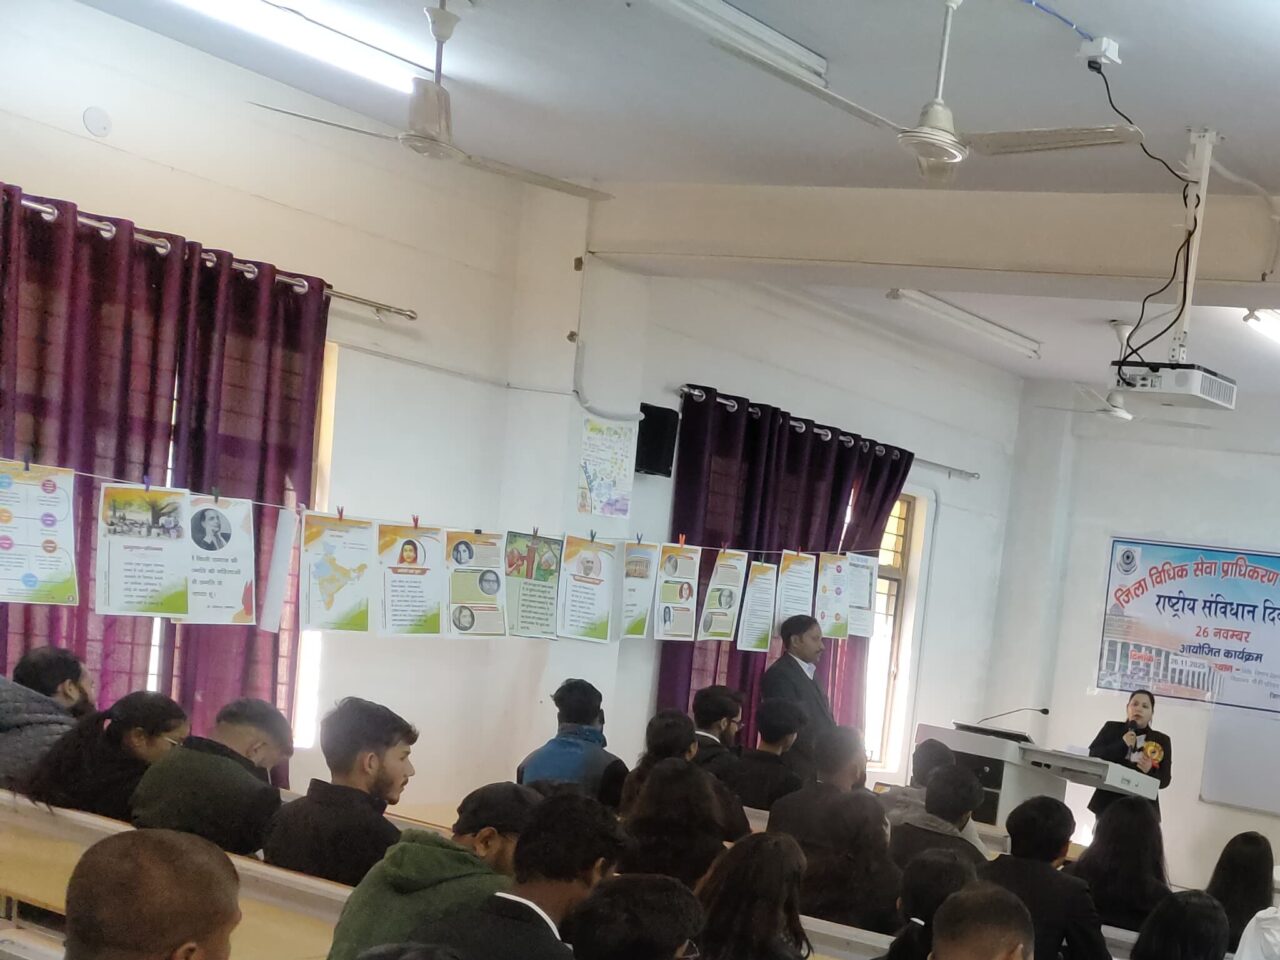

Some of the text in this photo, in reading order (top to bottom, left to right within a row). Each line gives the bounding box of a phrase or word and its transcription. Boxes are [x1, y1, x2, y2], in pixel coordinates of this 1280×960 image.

[1114, 577, 1148, 608] जिला
[1149, 561, 1188, 588] विधिक
[1193, 557, 1218, 577] सेवा
[1221, 556, 1280, 586] प्राधिकरण
[1155, 590, 1199, 618] राष्ट्रीय
[1201, 594, 1258, 622] संविधान
[1195, 626, 1251, 643] 26 नवम्बर
[1179, 643, 1263, 663] आयोजित कार्यक्रम
